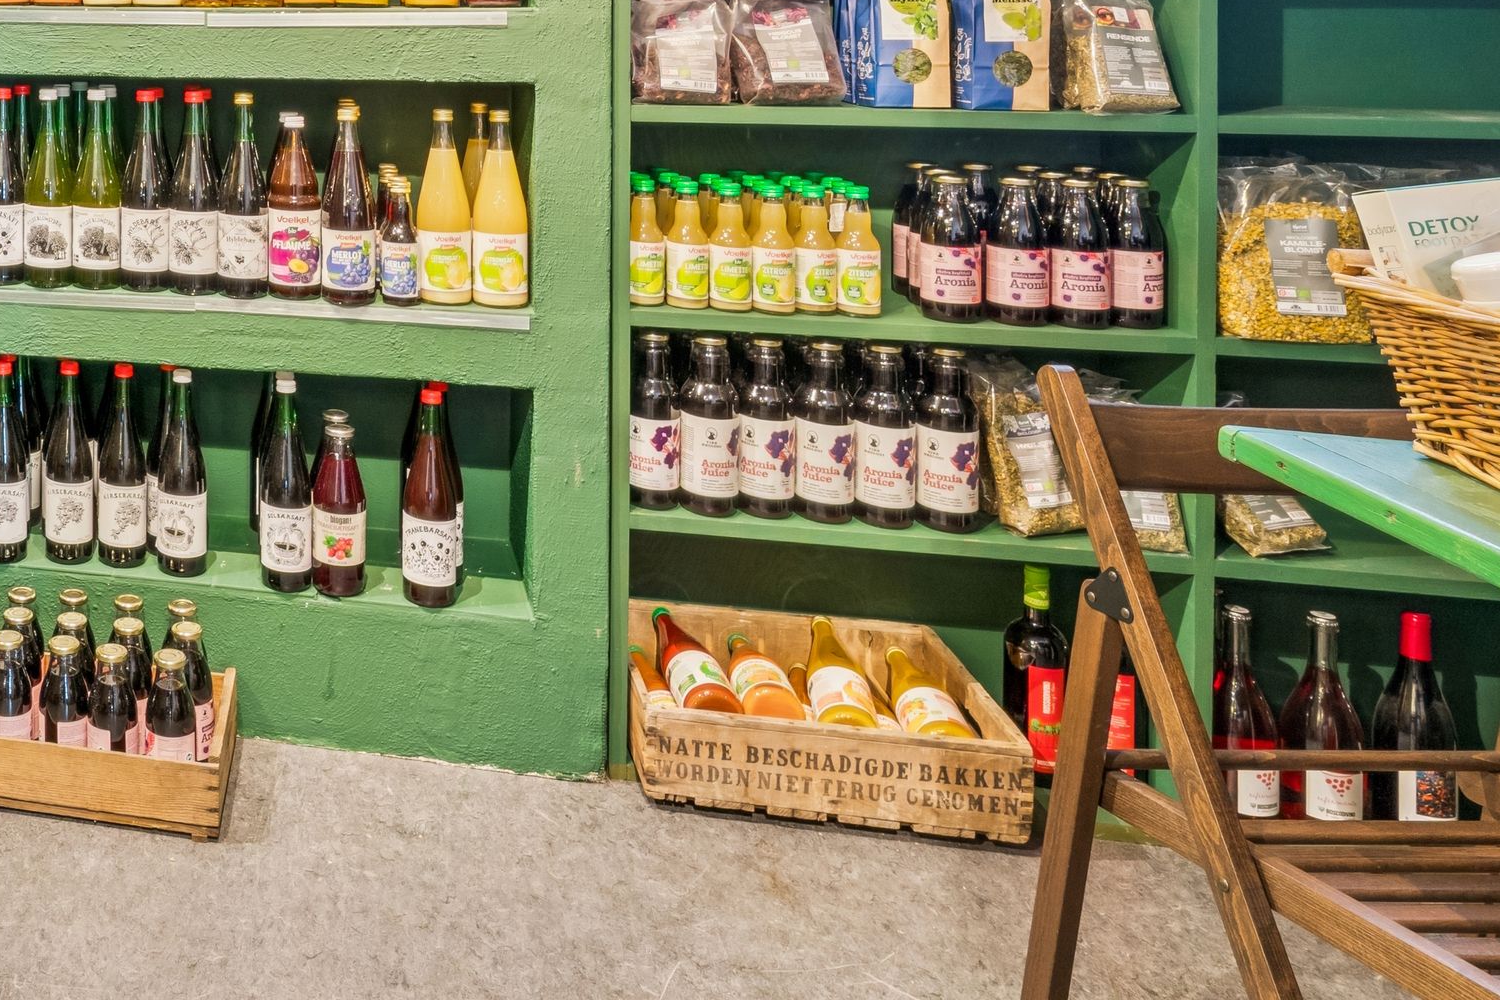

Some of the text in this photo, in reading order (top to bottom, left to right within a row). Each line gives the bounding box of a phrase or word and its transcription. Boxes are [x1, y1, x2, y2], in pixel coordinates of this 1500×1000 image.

[1106, 32, 1151, 43] RENSENDE
[276, 215, 310, 225] Voelkel
[1407, 214, 1480, 237] DETOX
[335, 233, 363, 242] Voelkel
[434, 235, 462, 244] Voelkel
[488, 237, 517, 246] Voelkel
[1279, 239, 1326, 248] KAMILLE-
[272, 240, 311, 251] PFLAUME
[1283, 246, 1326, 254] BLOMST
[331, 250, 363, 260] MERLOT
[384, 260, 410, 269] MERLOT
[934, 275, 976, 287] Aronia
[1060, 281, 1106, 293] Aronia
[701, 459, 735, 468] Aronia
[740, 456, 777, 471] Aronia
[802, 462, 840, 476] Aronia
[701, 468, 730, 477] Juice
[740, 466, 769, 478] Juice
[802, 471, 833, 484] Juice
[863, 466, 903, 480] Aronia
[923, 469, 963, 484] Aronia
[863, 475, 895, 488] Juice
[923, 478, 955, 491] Juice
[658, 735, 1022, 791] NATTE BESCHADIGDE BAKKEN
[655, 758, 1019, 816] WORDEN NIET TERUG GENOMEN
